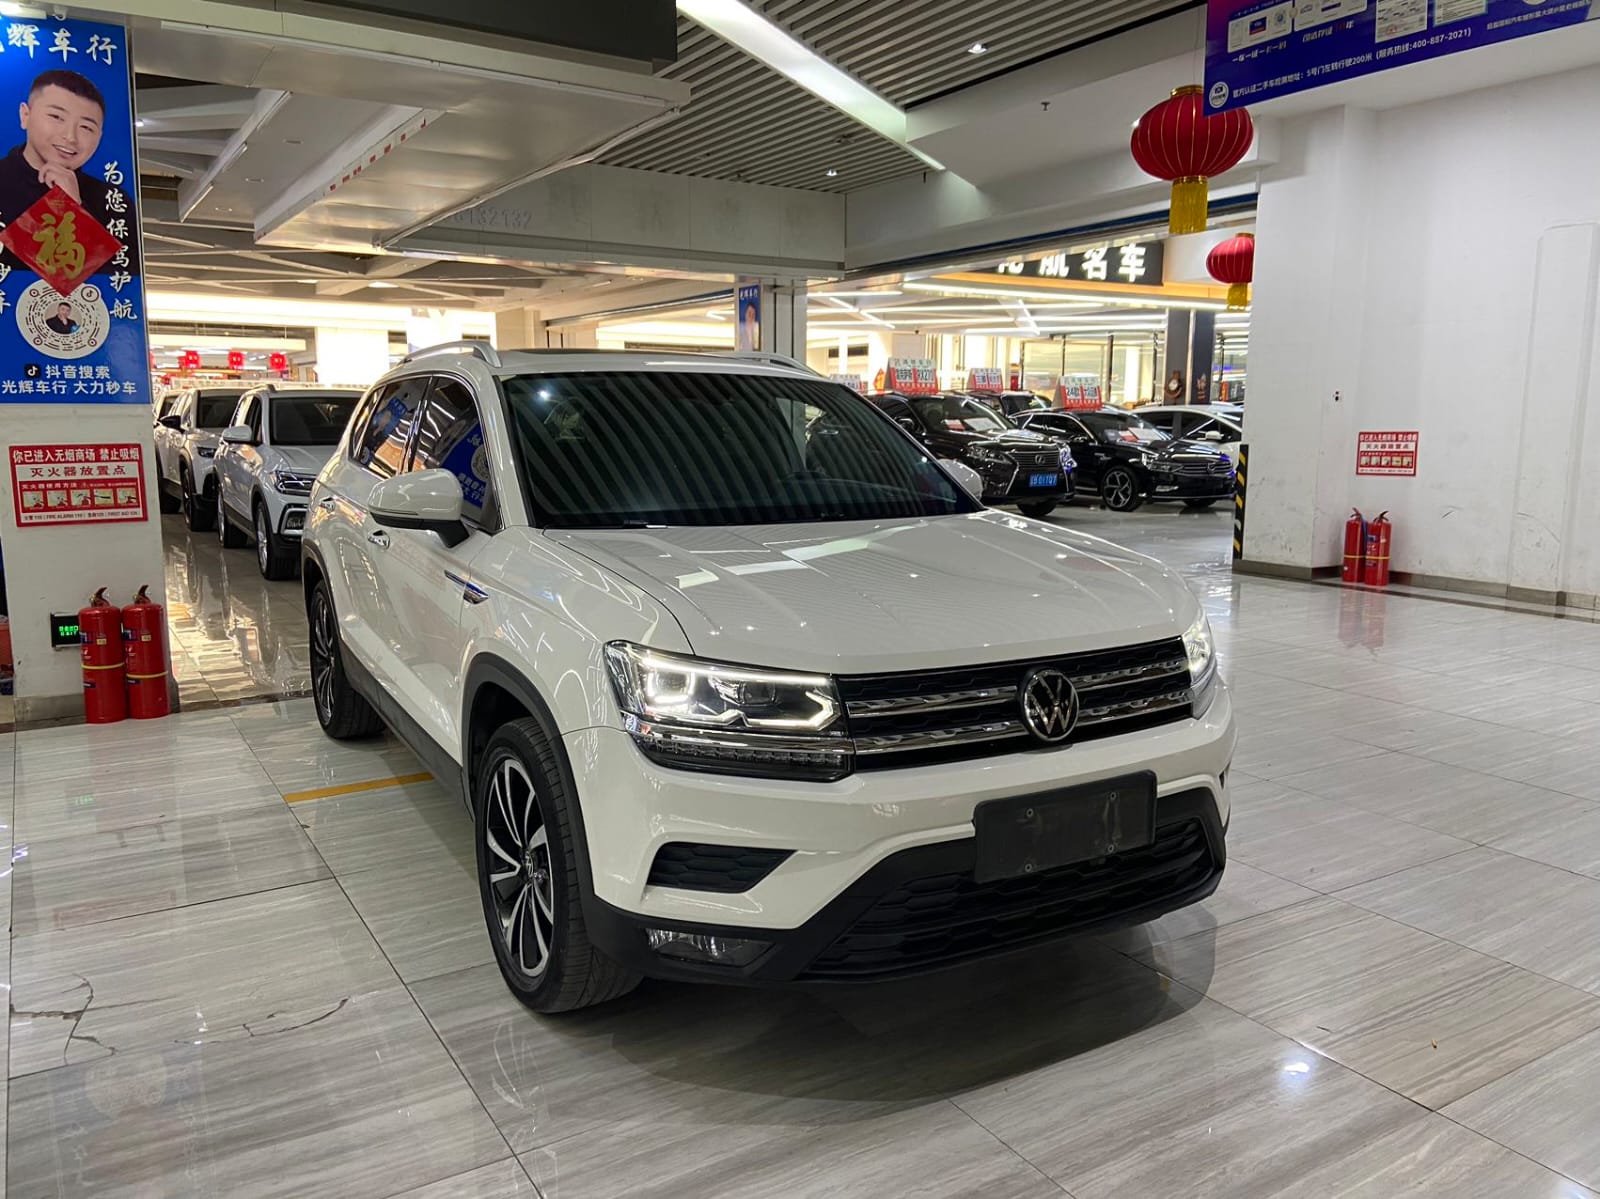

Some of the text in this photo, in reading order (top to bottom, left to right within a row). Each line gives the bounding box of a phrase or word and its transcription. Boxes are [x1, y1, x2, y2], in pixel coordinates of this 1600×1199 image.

[0, 23, 117, 65] 辉车行
[33, 211, 86, 281] 福
[45, 364, 111, 380] 抖音搜索
[2, 380, 137, 395] 光辉车行 大力秒车
[13, 447, 140, 463] 你已进入无烟商场 禁止吸烟
[30, 465, 127, 478] 灭火器放置点
